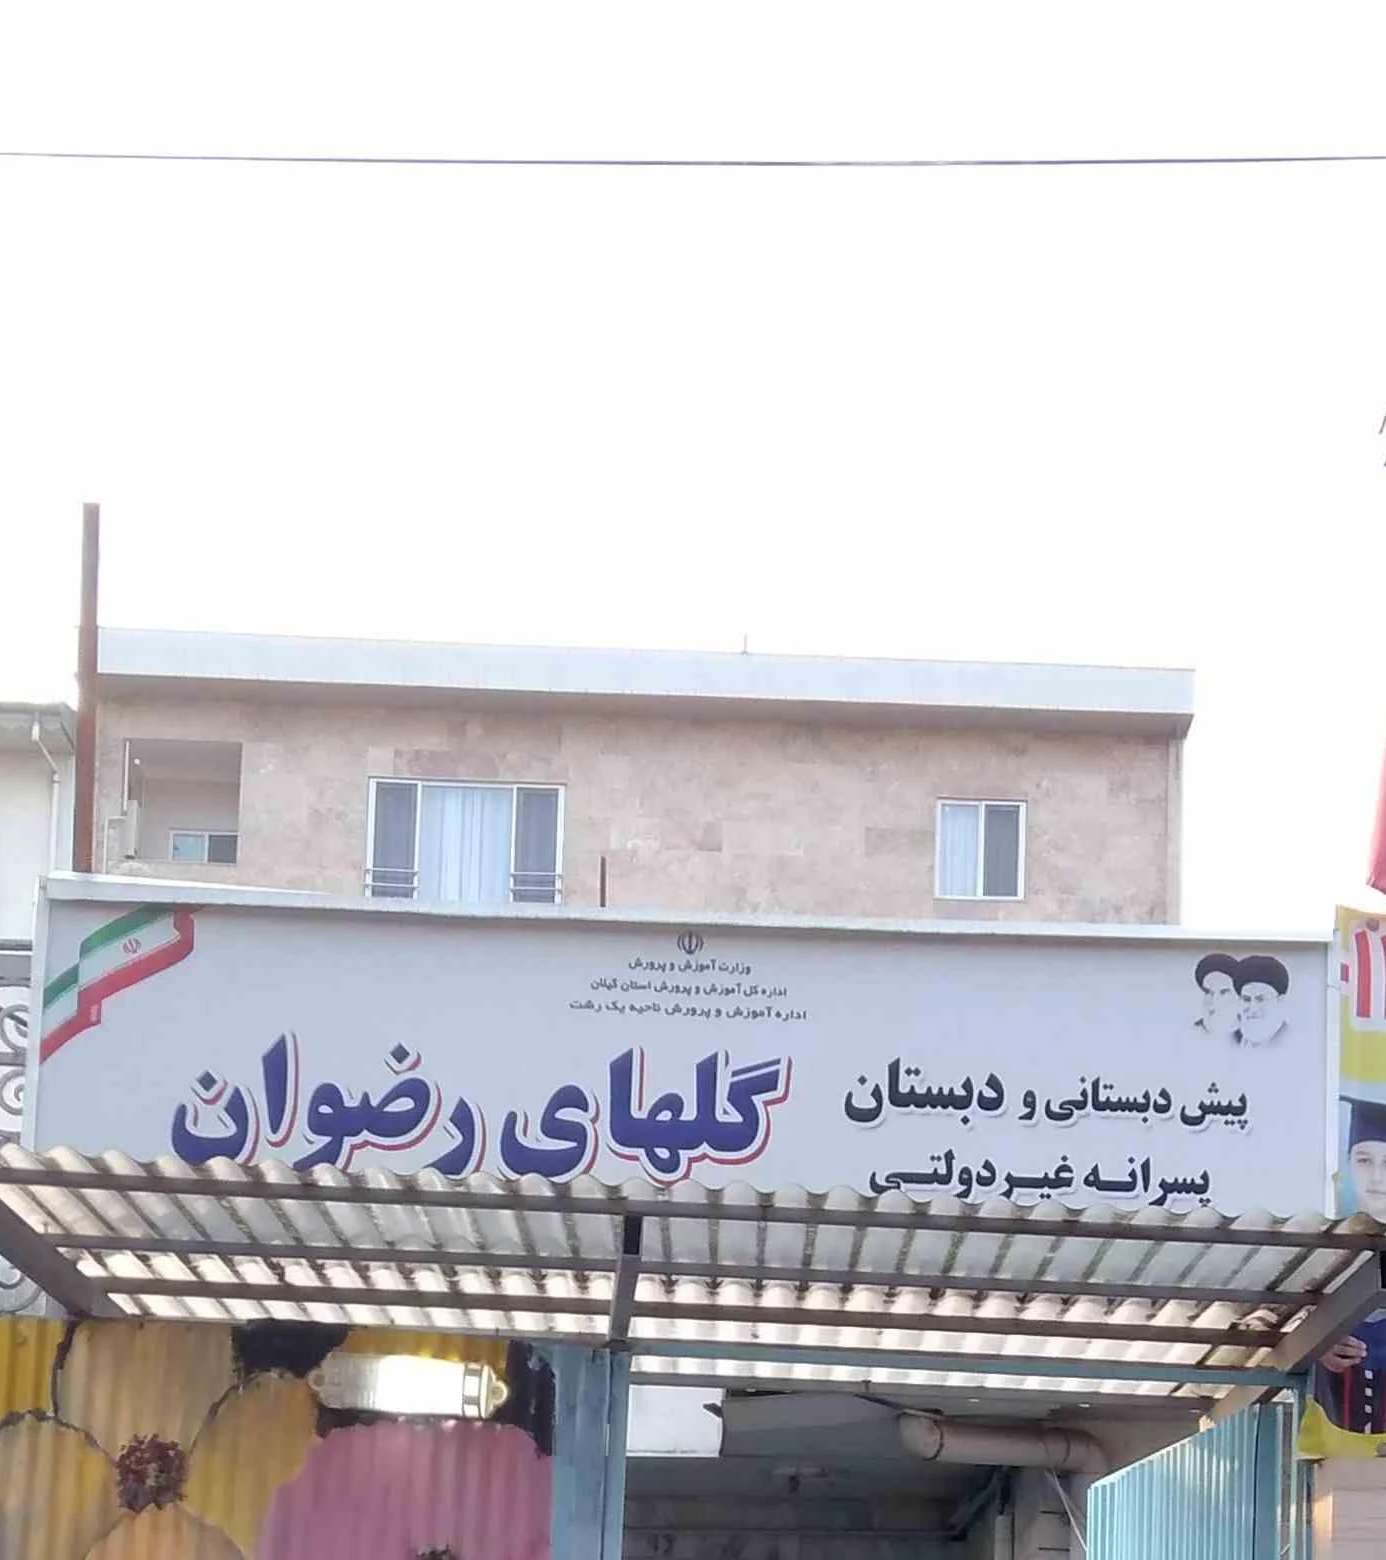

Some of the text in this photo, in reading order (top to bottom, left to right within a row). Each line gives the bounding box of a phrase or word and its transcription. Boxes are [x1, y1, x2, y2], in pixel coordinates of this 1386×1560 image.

[628, 956, 667, 973] پرورش
[678, 958, 716, 974] آموزش
[718, 960, 751, 975] وزارت
[590, 977, 618, 991] گیلان
[620, 979, 651, 992] استان
[653, 980, 692, 996] پرورش
[703, 982, 742, 997] آموزش
[743, 983, 759, 997] کل
[761, 985, 788, 998] اداره
[569, 999, 602, 1013] رشت
[605, 1000, 626, 1014] یک
[628, 1002, 661, 1015] ناحیه
[665, 1003, 712, 1020] پرورش
[726, 1005, 772, 1020] آموزش
[775, 1008, 807, 1021] اداره
[843, 1056, 1248, 1131] پیش دبستانی و دبستان
[170, 1032, 786, 1178] گلهای رضوان
[1082, 1155, 1213, 1208] پسرانه
